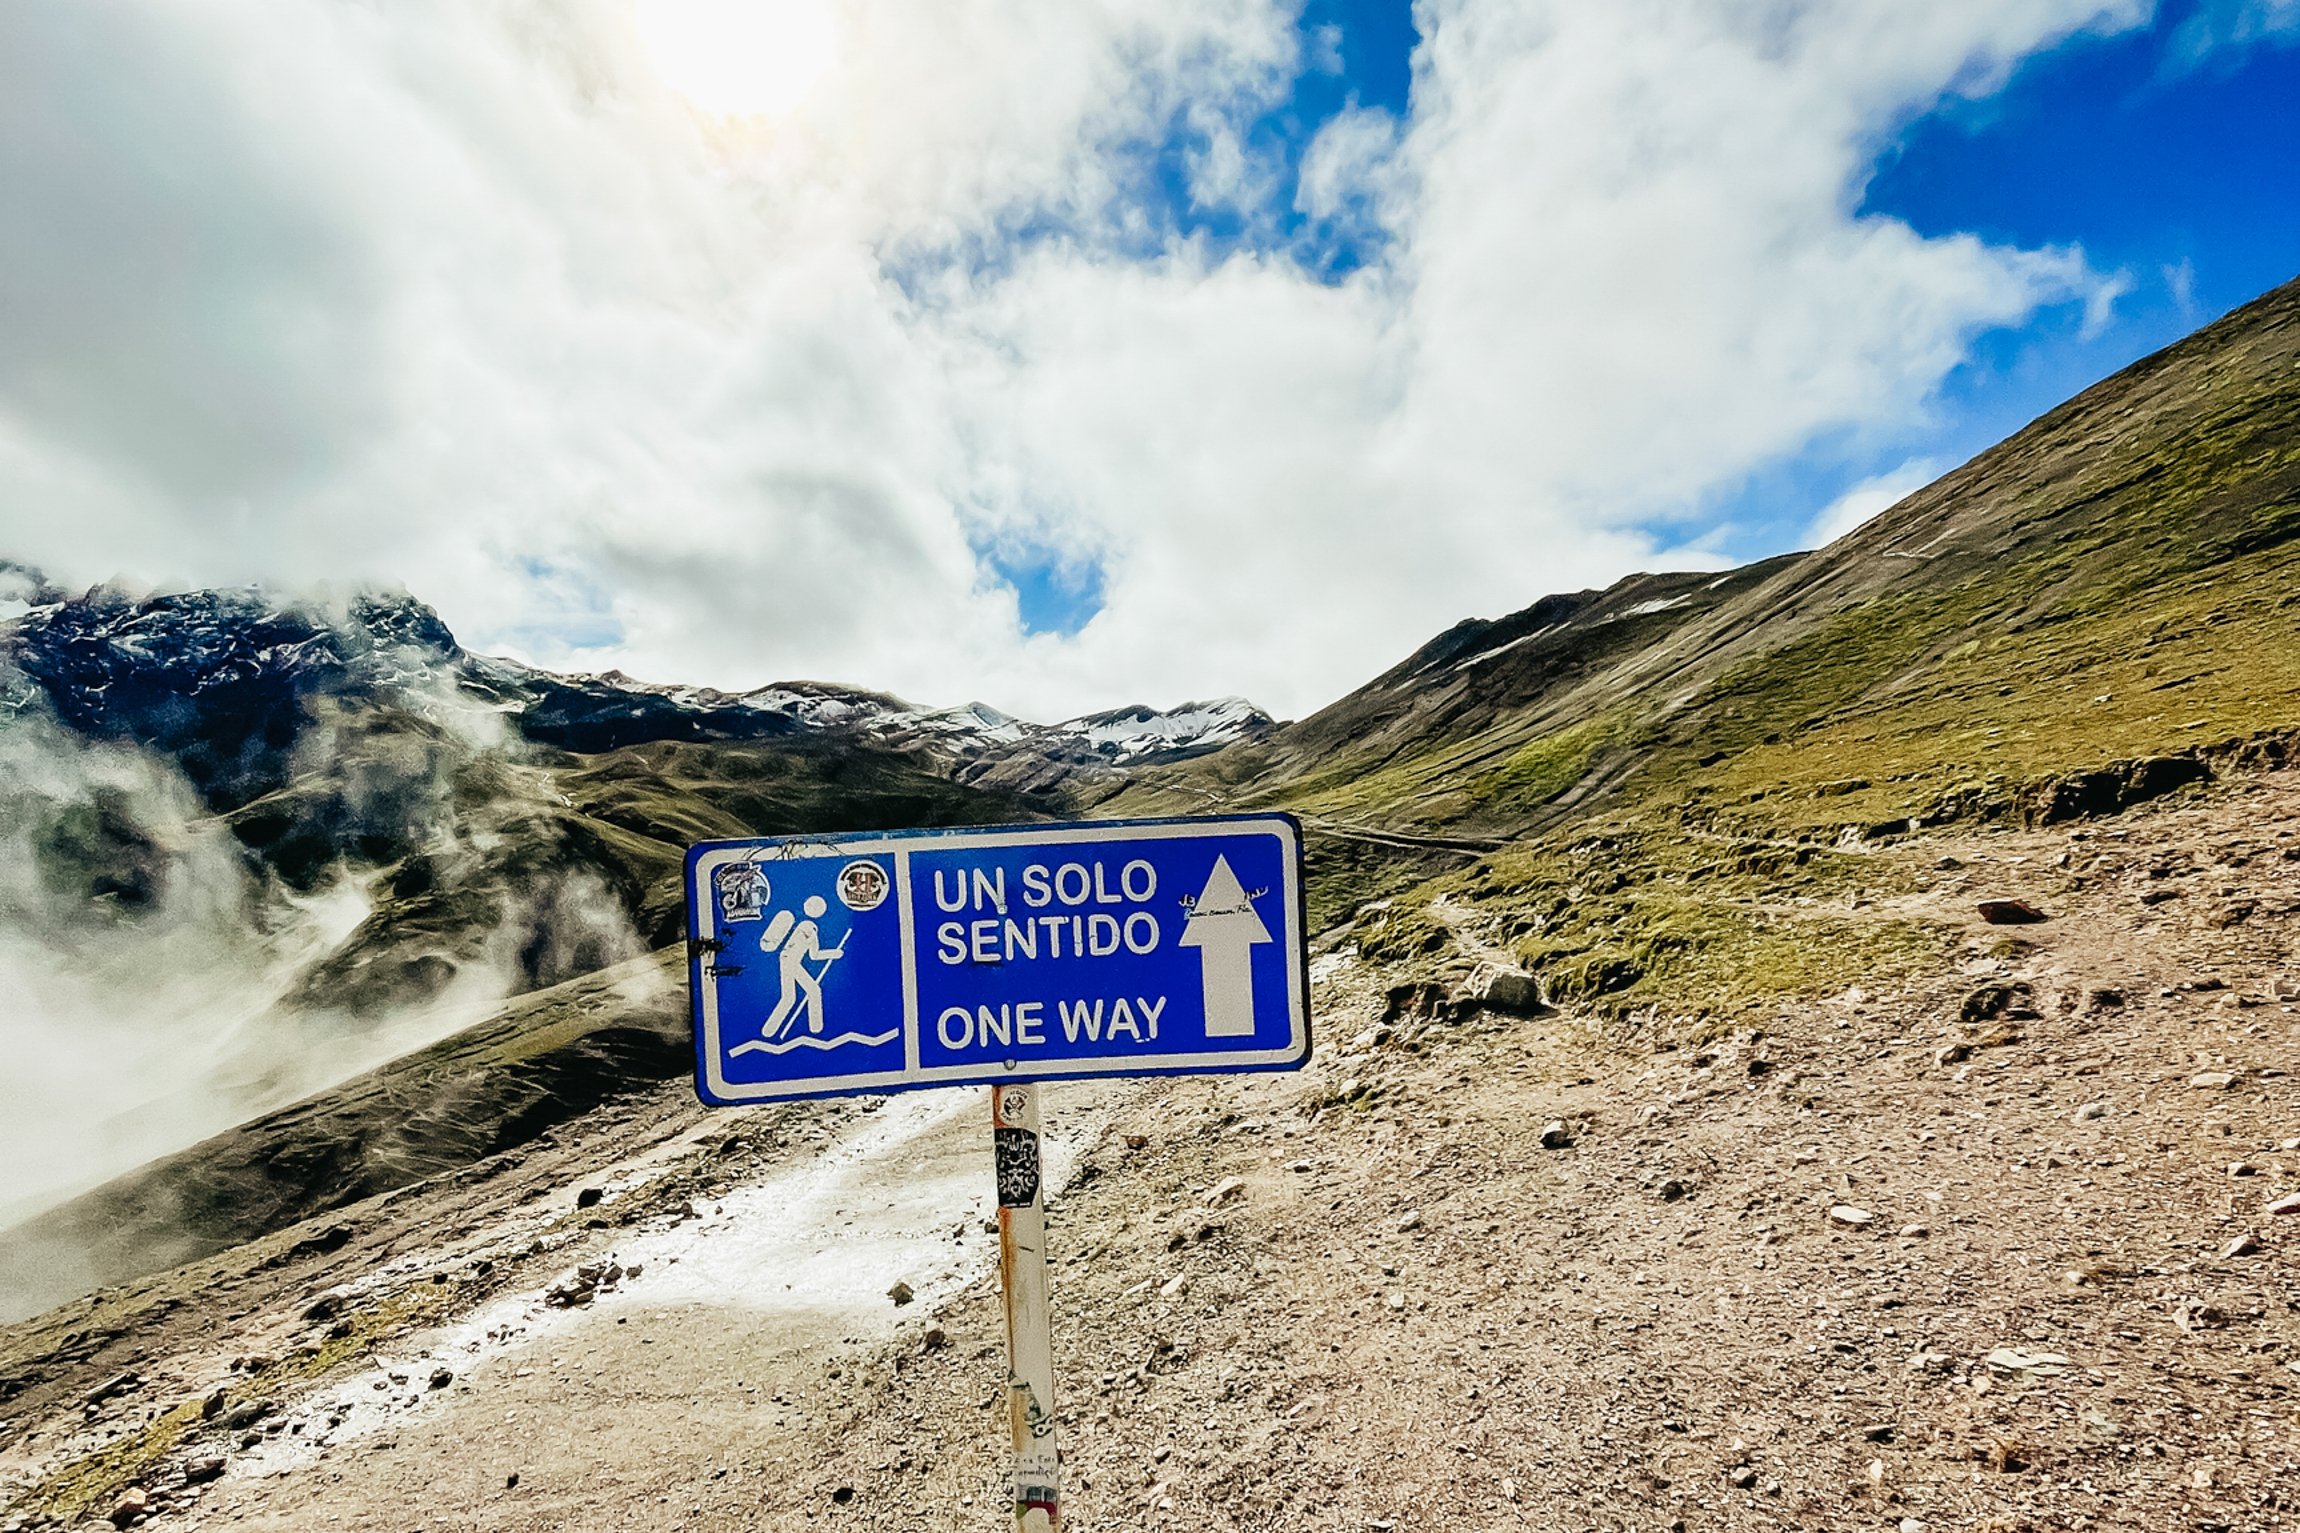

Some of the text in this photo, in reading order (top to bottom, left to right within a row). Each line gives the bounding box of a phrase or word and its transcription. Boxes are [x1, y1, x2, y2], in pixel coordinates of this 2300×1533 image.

[934, 859, 1157, 915] UN SOLO
[937, 911, 1160, 965] SENTIDO
[936, 995, 1167, 1050] ONE WAY
